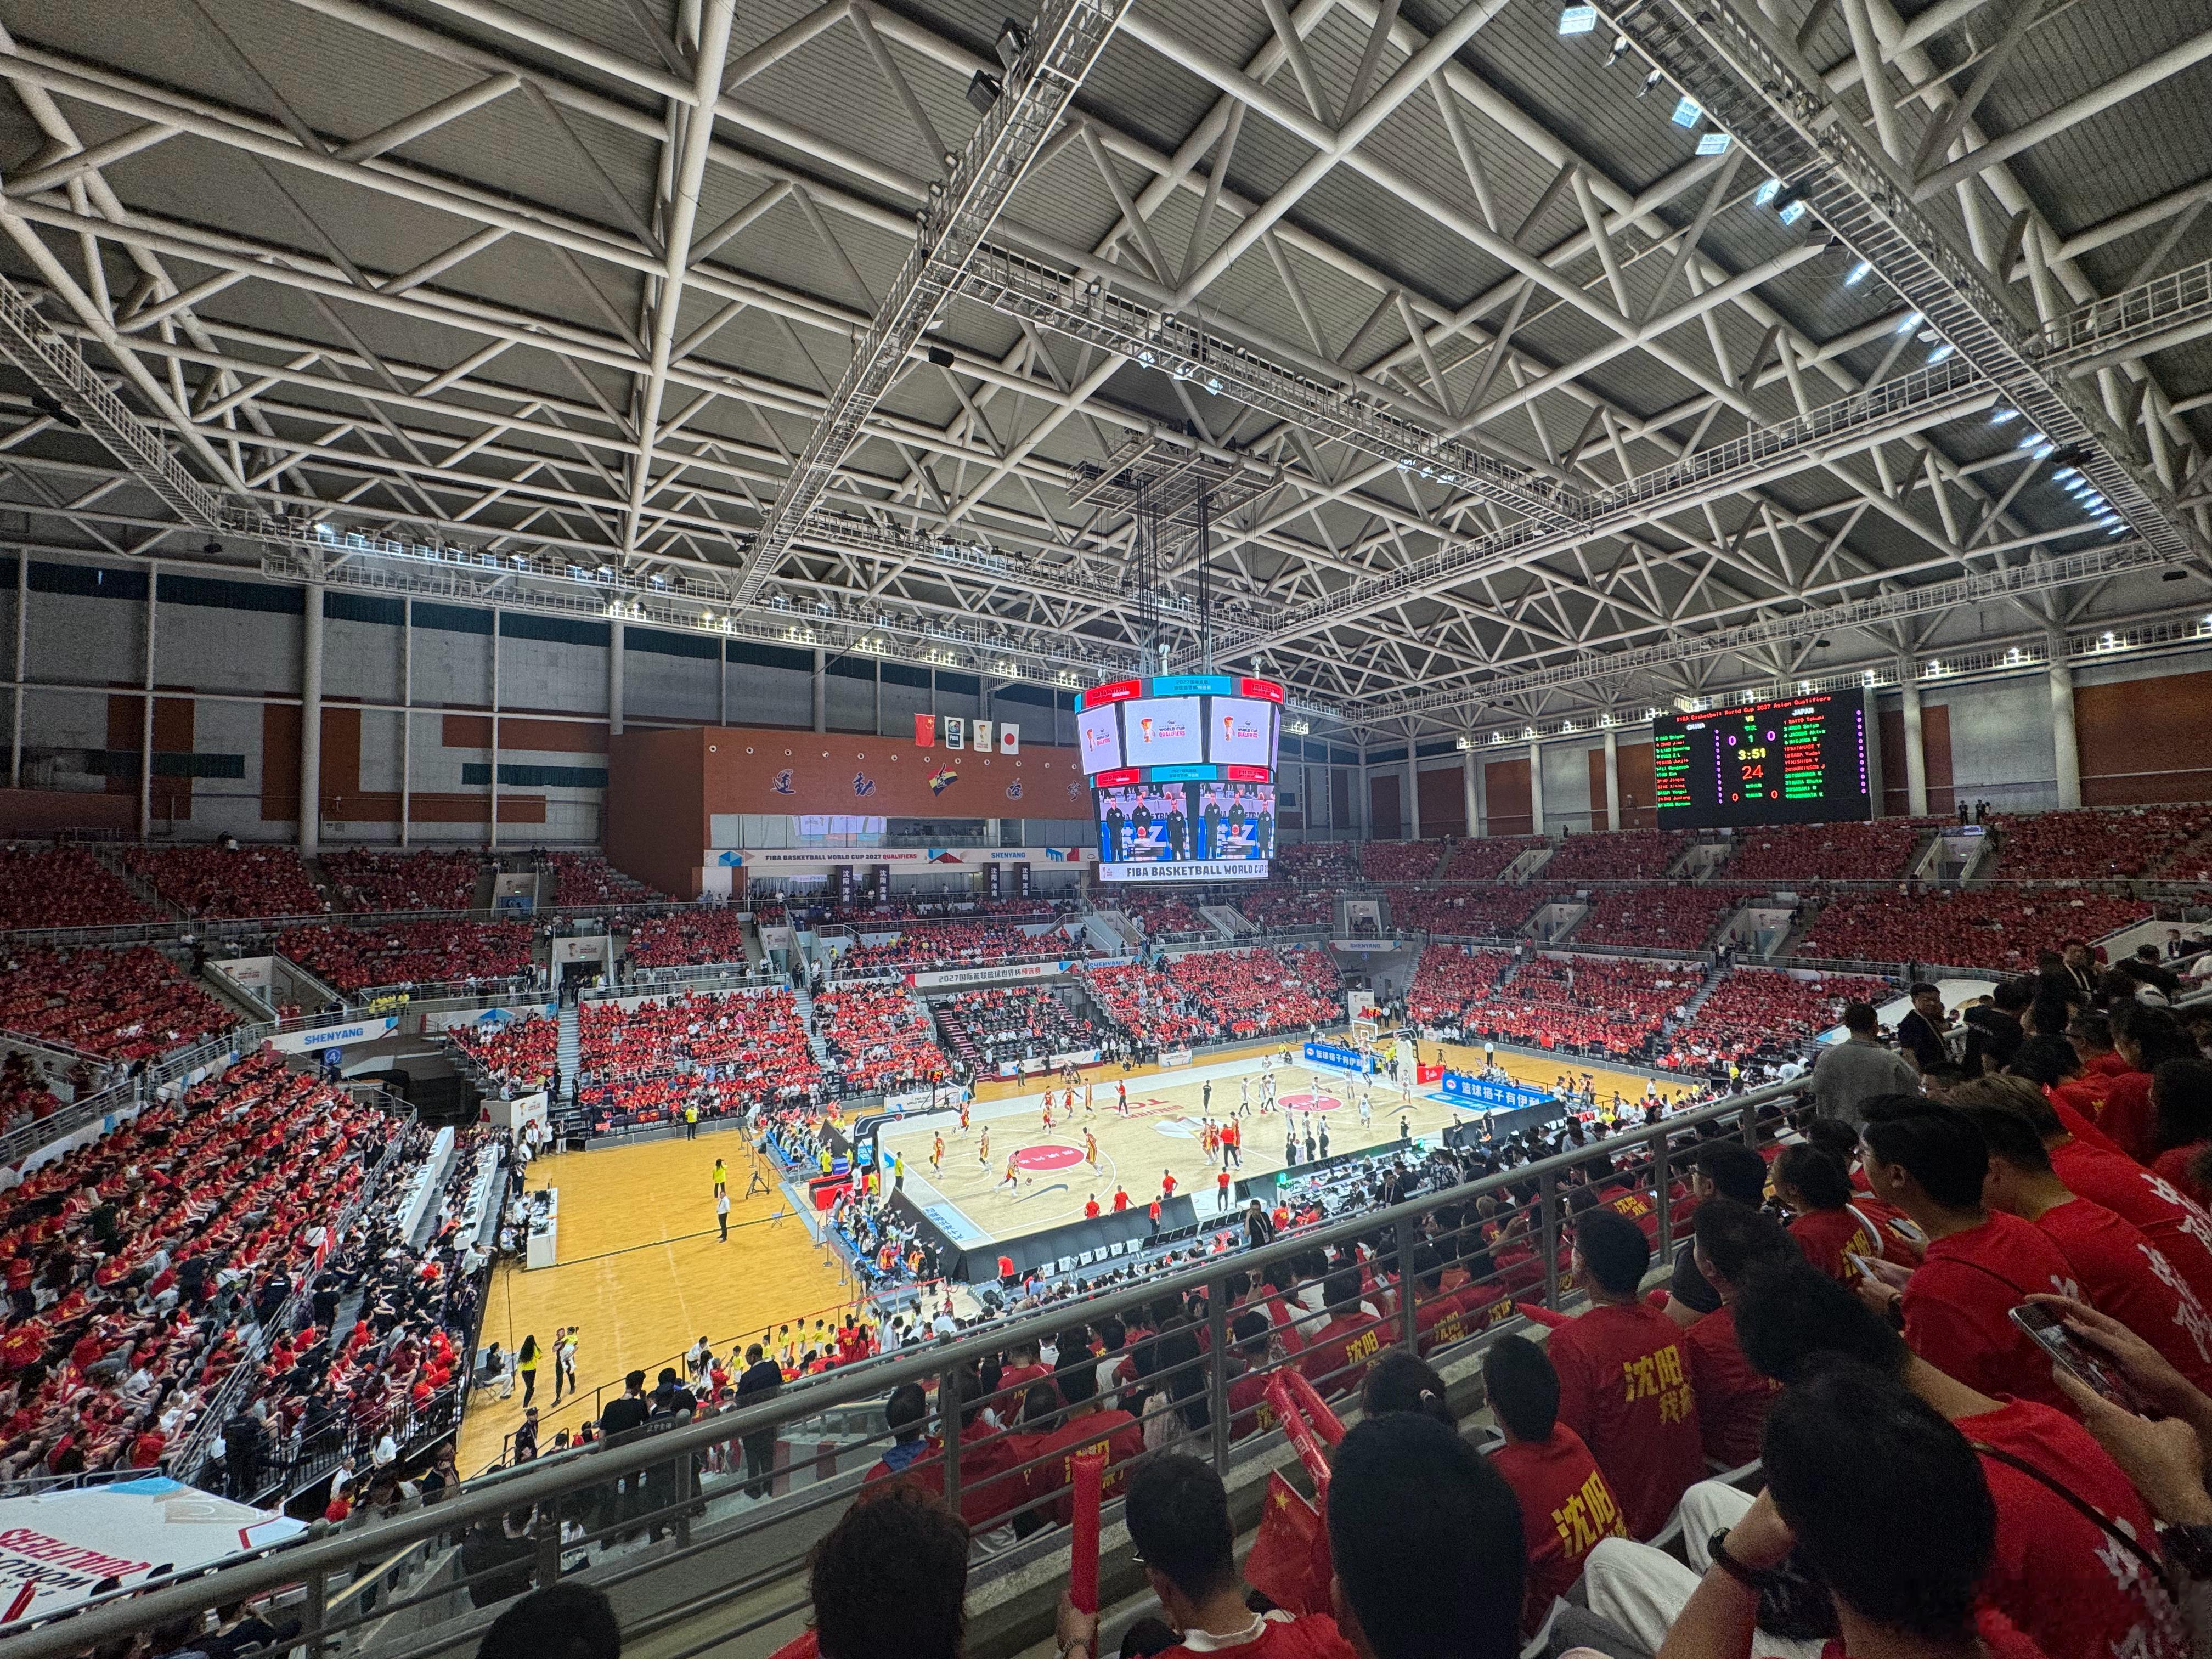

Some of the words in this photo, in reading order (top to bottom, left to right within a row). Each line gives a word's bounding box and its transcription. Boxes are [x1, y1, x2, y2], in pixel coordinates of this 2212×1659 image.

[1792, 707, 1814, 716] JAPAN
[1728, 736, 1736, 746] 0
[1748, 735, 1753, 743] 1
[1767, 731, 1775, 741] 0
[1738, 748, 1766, 760] 3:51
[1742, 765, 1763, 780] 24
[1732, 793, 1739, 802] 0
[1771, 790, 1778, 799] 0
[1127, 867, 1148, 877] FIBA
[1152, 866, 1222, 876] BASKETBALL
[1224, 865, 1253, 874] WORLD
[1254, 865, 1264, 873] CUP
[304, 1028, 363, 1045] SHENYANG
[330, 1053, 336, 1062] 4
[1345, 1330, 1379, 1365] 沈阳
[1623, 1345, 1683, 1402] 沈阳
[1551, 1470, 1616, 1558] 沈阳
